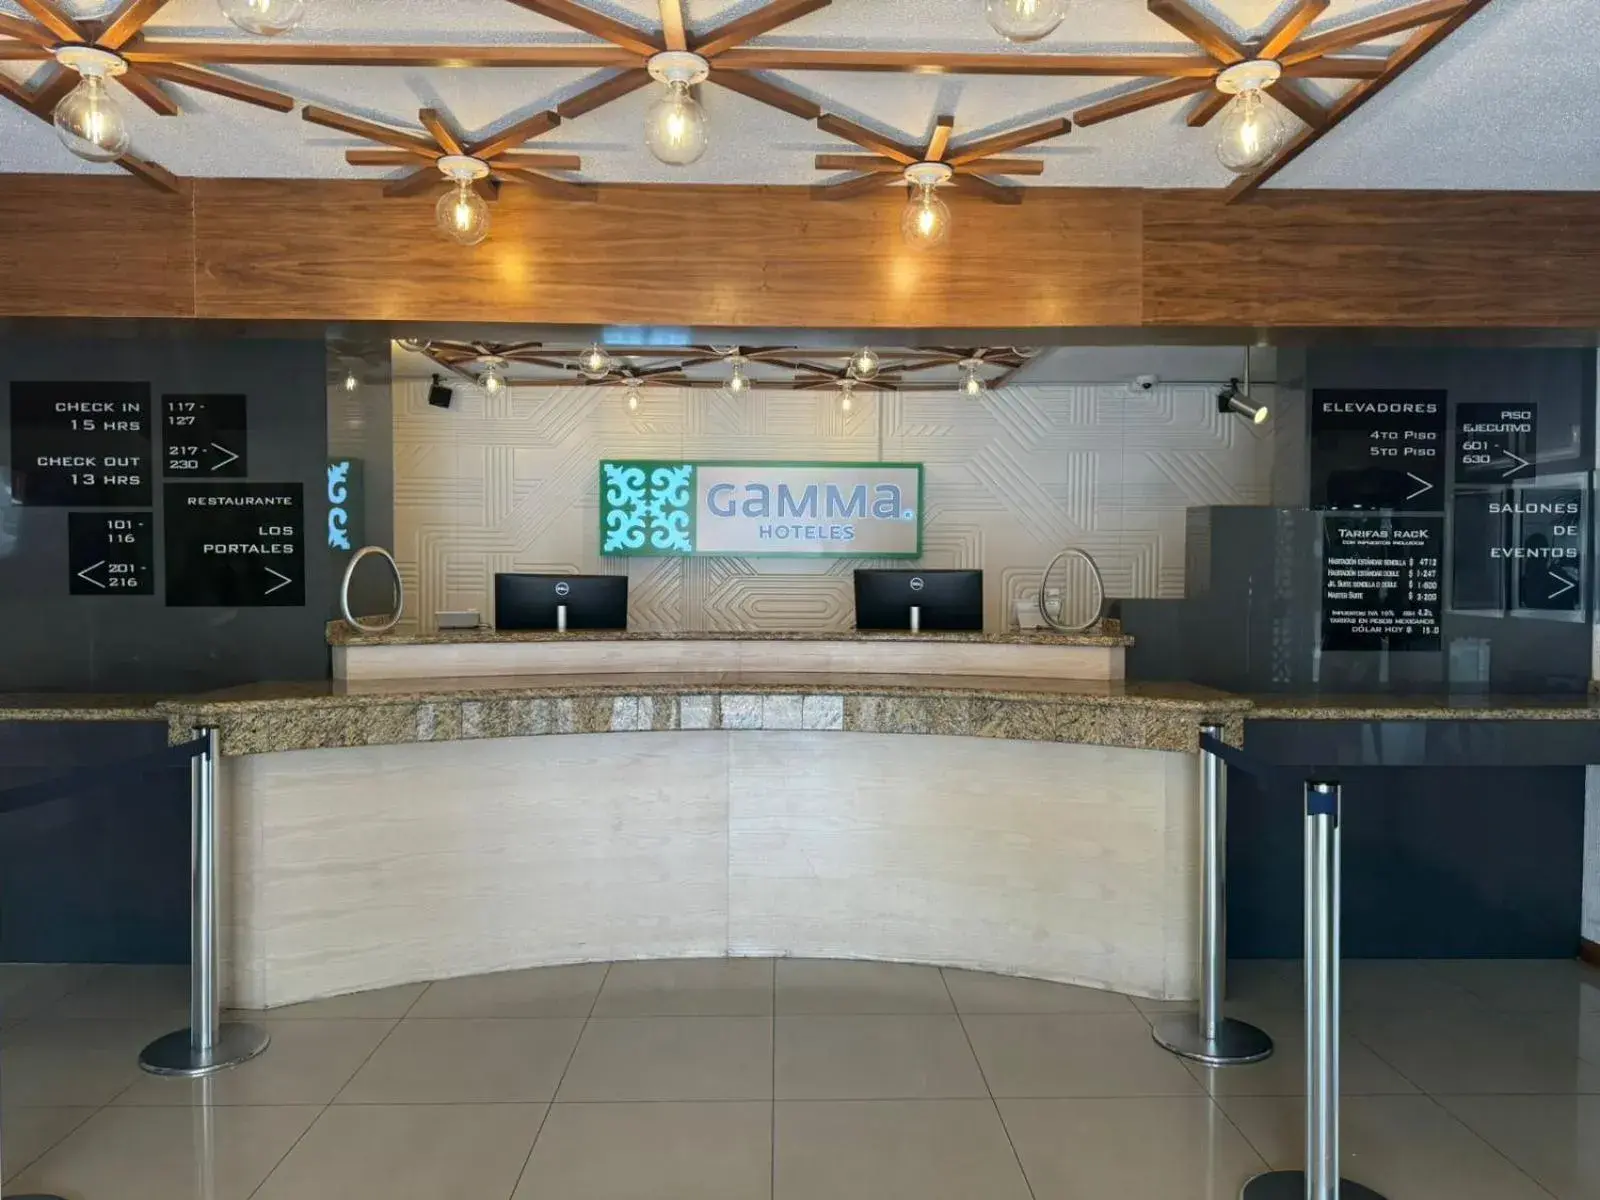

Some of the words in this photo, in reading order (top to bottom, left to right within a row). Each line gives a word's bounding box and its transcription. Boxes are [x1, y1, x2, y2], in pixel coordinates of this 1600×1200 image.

[55, 402, 114, 412] CHECK
[122, 402, 140, 412] IN
[168, 402, 196, 412] 117
[1323, 403, 1437, 413] ELEVADORES
[1501, 411, 1531, 420] PISO
[70, 419, 96, 431] 15
[104, 421, 140, 431] HRS
[168, 416, 195, 426] 127
[1463, 424, 1531, 432] EJECUTIVO
[169, 446, 198, 456] 217
[37, 456, 96, 466] CHECK
[104, 456, 140, 466] OUT
[1463, 454, 1490, 463] 630
[169, 460, 198, 469] 230
[70, 473, 96, 485] 13
[104, 475, 140, 485] HRS
[188, 497, 292, 506] RESTAURANTE
[1489, 504, 1578, 514] SALONES
[258, 526, 293, 536] LOS
[759, 525, 855, 540] HOTELES
[1554, 526, 1577, 536] DE
[107, 534, 135, 543] 116
[204, 544, 294, 554] PORTALES
[1491, 548, 1577, 558] EVENTOS
[108, 564, 135, 573] 201
[109, 578, 137, 587] 216
